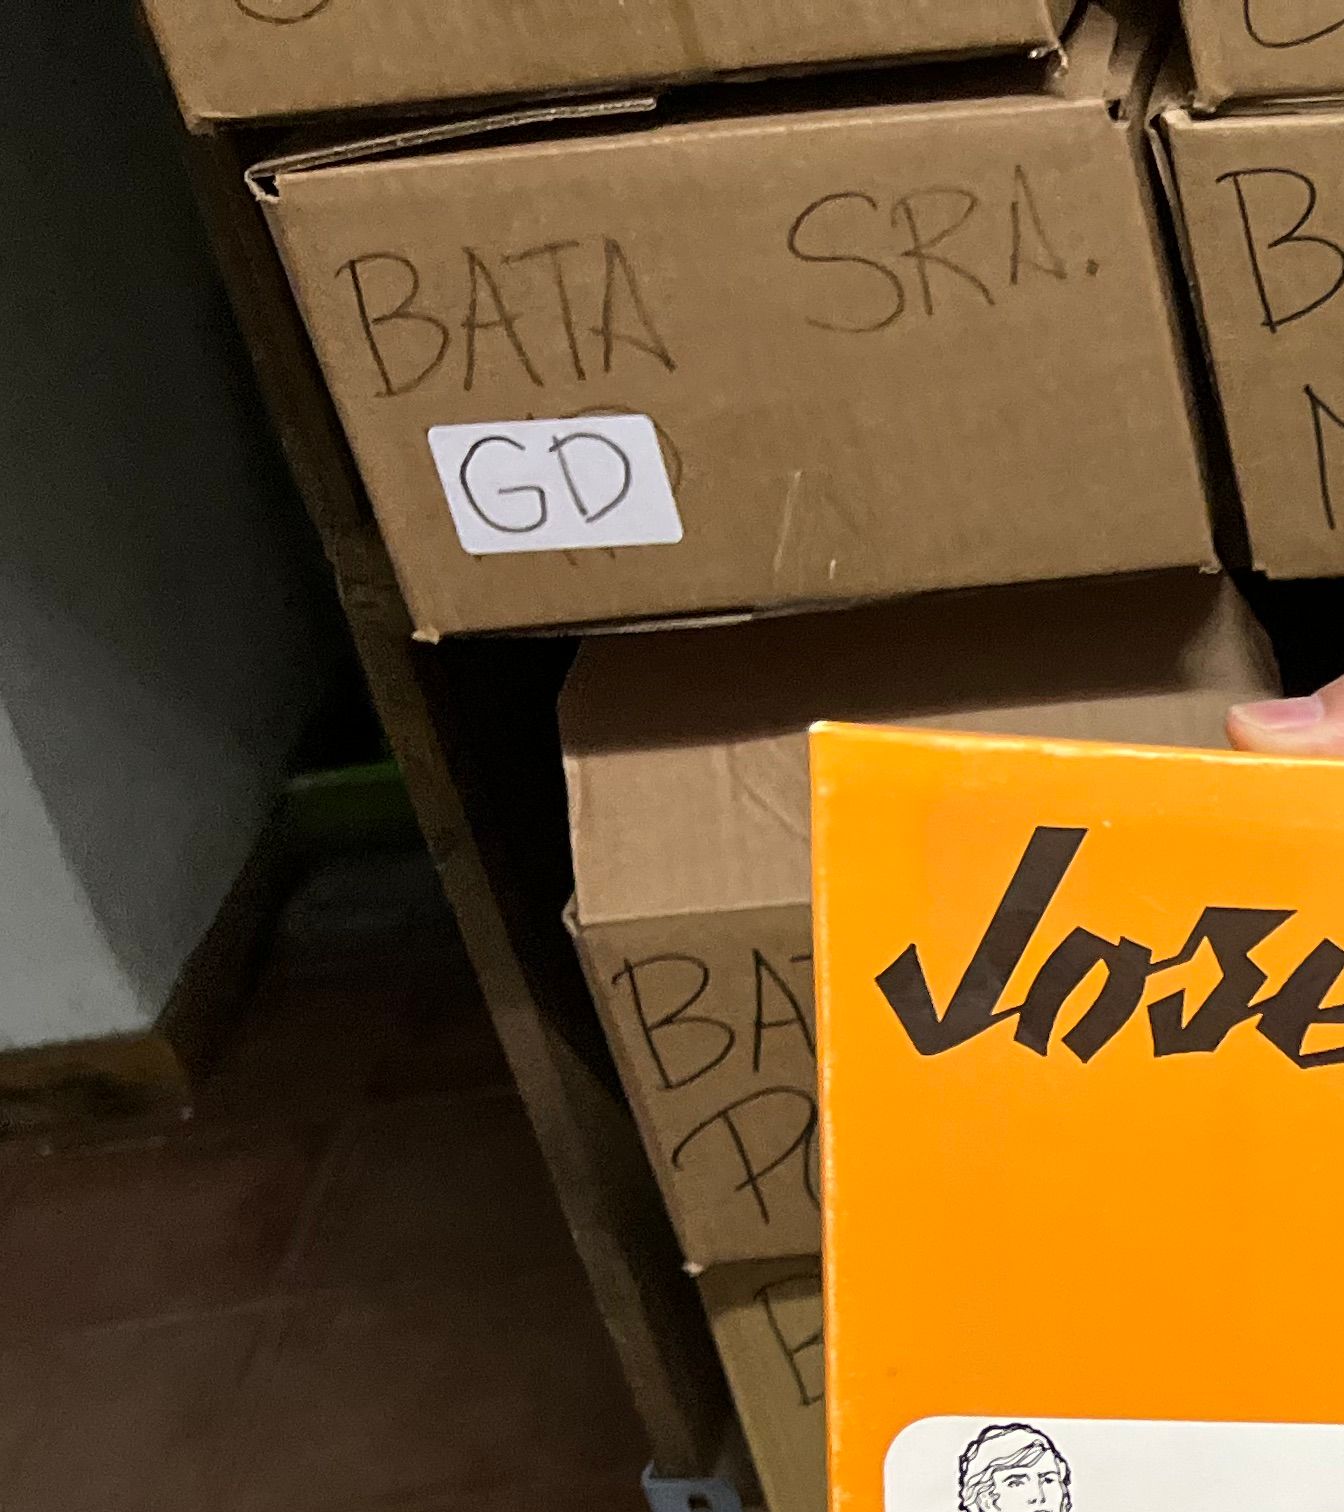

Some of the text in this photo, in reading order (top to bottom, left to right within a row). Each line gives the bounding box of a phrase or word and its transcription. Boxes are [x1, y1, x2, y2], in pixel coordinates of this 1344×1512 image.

[334, 237, 676, 398] BATA
[458, 431, 633, 533] GD
[611, 947, 816, 1092] BA
